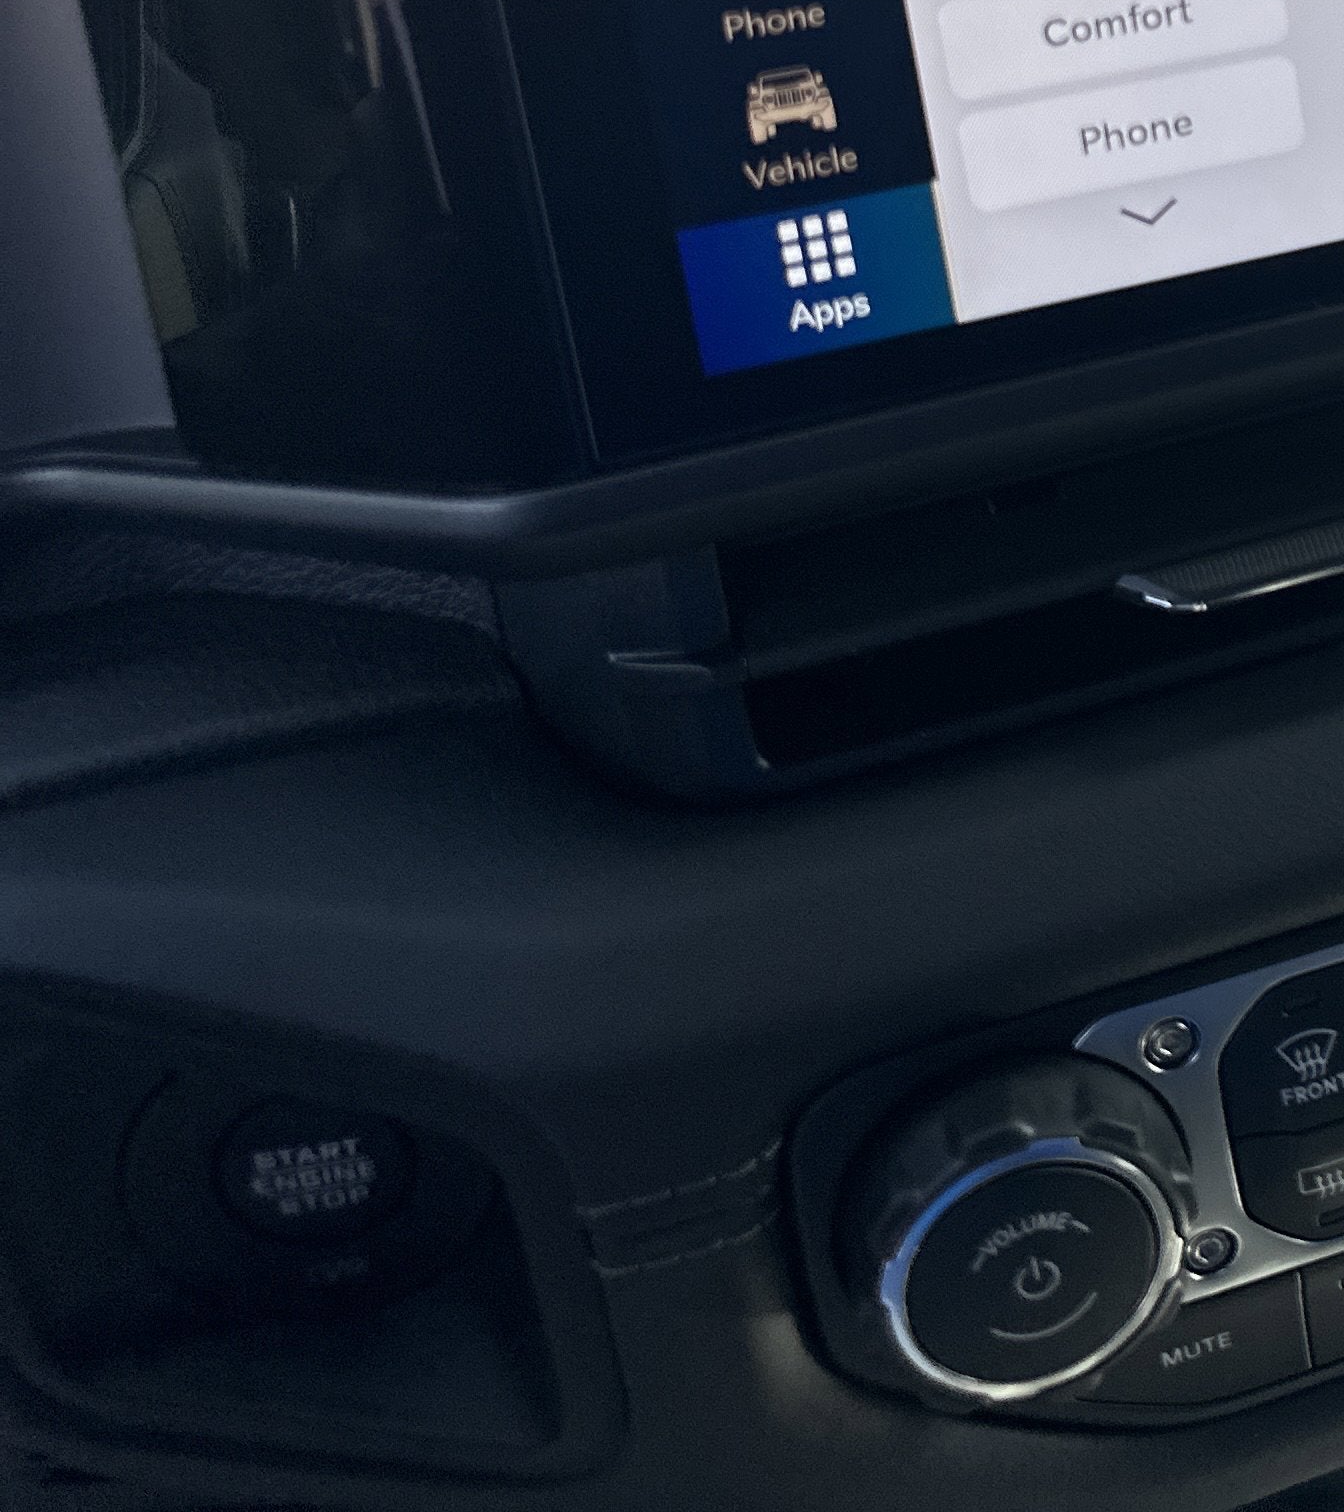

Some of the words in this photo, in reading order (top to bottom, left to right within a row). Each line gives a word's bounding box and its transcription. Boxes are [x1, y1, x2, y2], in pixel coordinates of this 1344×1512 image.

[722, 1, 826, 43] Phone
[1079, 112, 1193, 158] Phone
[742, 144, 859, 190] Vehicle
[788, 292, 871, 333] Apps
[980, 1212, 1073, 1257] VOLUME
[1161, 1331, 1233, 1368] MUTE
